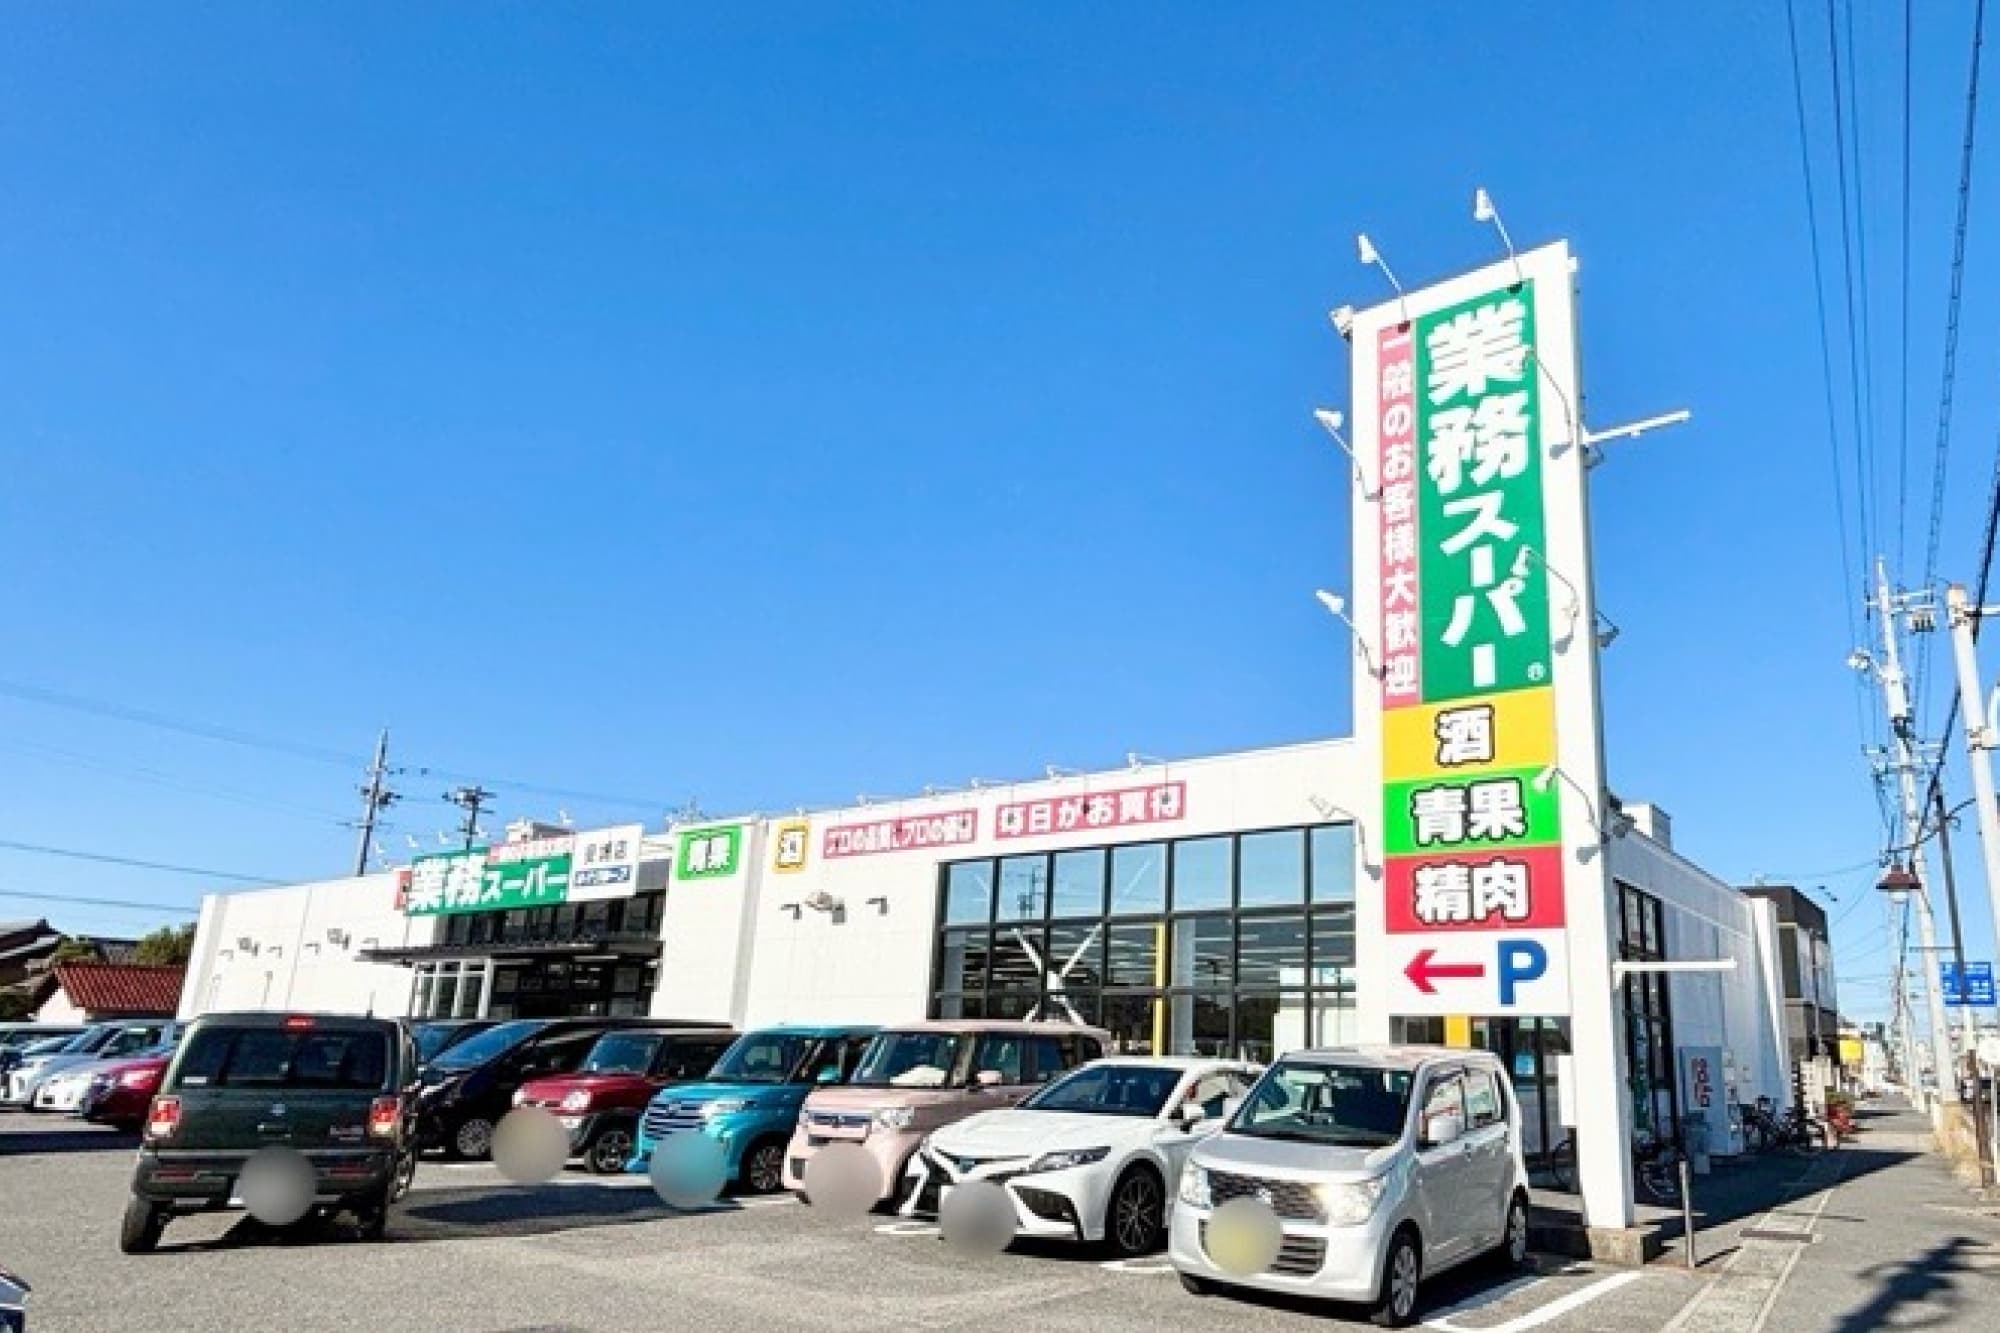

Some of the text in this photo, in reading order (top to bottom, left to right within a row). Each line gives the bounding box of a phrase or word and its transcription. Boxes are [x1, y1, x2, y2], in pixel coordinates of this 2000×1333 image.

[1427, 301, 1530, 687] 業務スーパー
[1435, 704, 1495, 767] 酒
[1411, 777, 1528, 847] 青果
[409, 854, 569, 912] 業務スーパー
[1413, 856, 1532, 925] 精肉
[1497, 940, 1548, 1005] P
